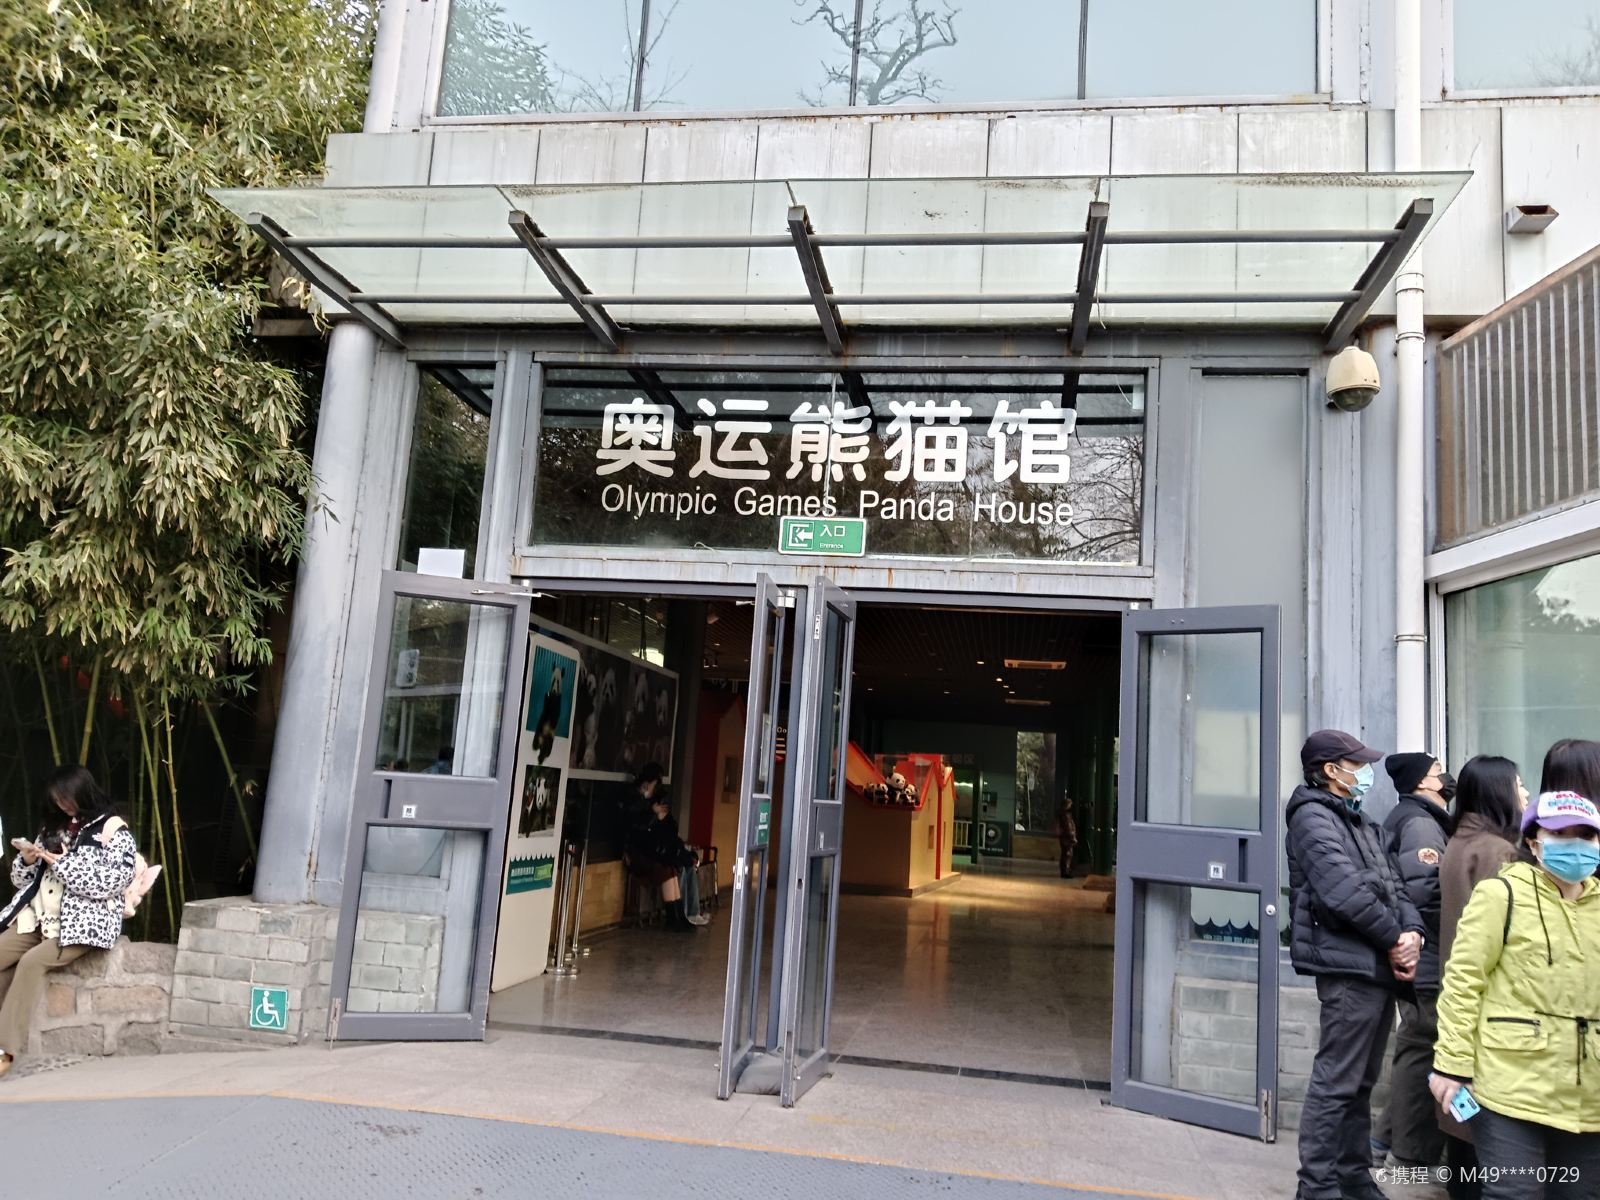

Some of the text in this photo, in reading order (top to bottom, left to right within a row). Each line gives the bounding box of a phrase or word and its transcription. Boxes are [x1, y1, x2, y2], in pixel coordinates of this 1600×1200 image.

[596, 397, 1077, 484] 奥运熊猫馆
[601, 483, 1074, 525] Olympic Games Panda House
[819, 524, 846, 538] 入口
